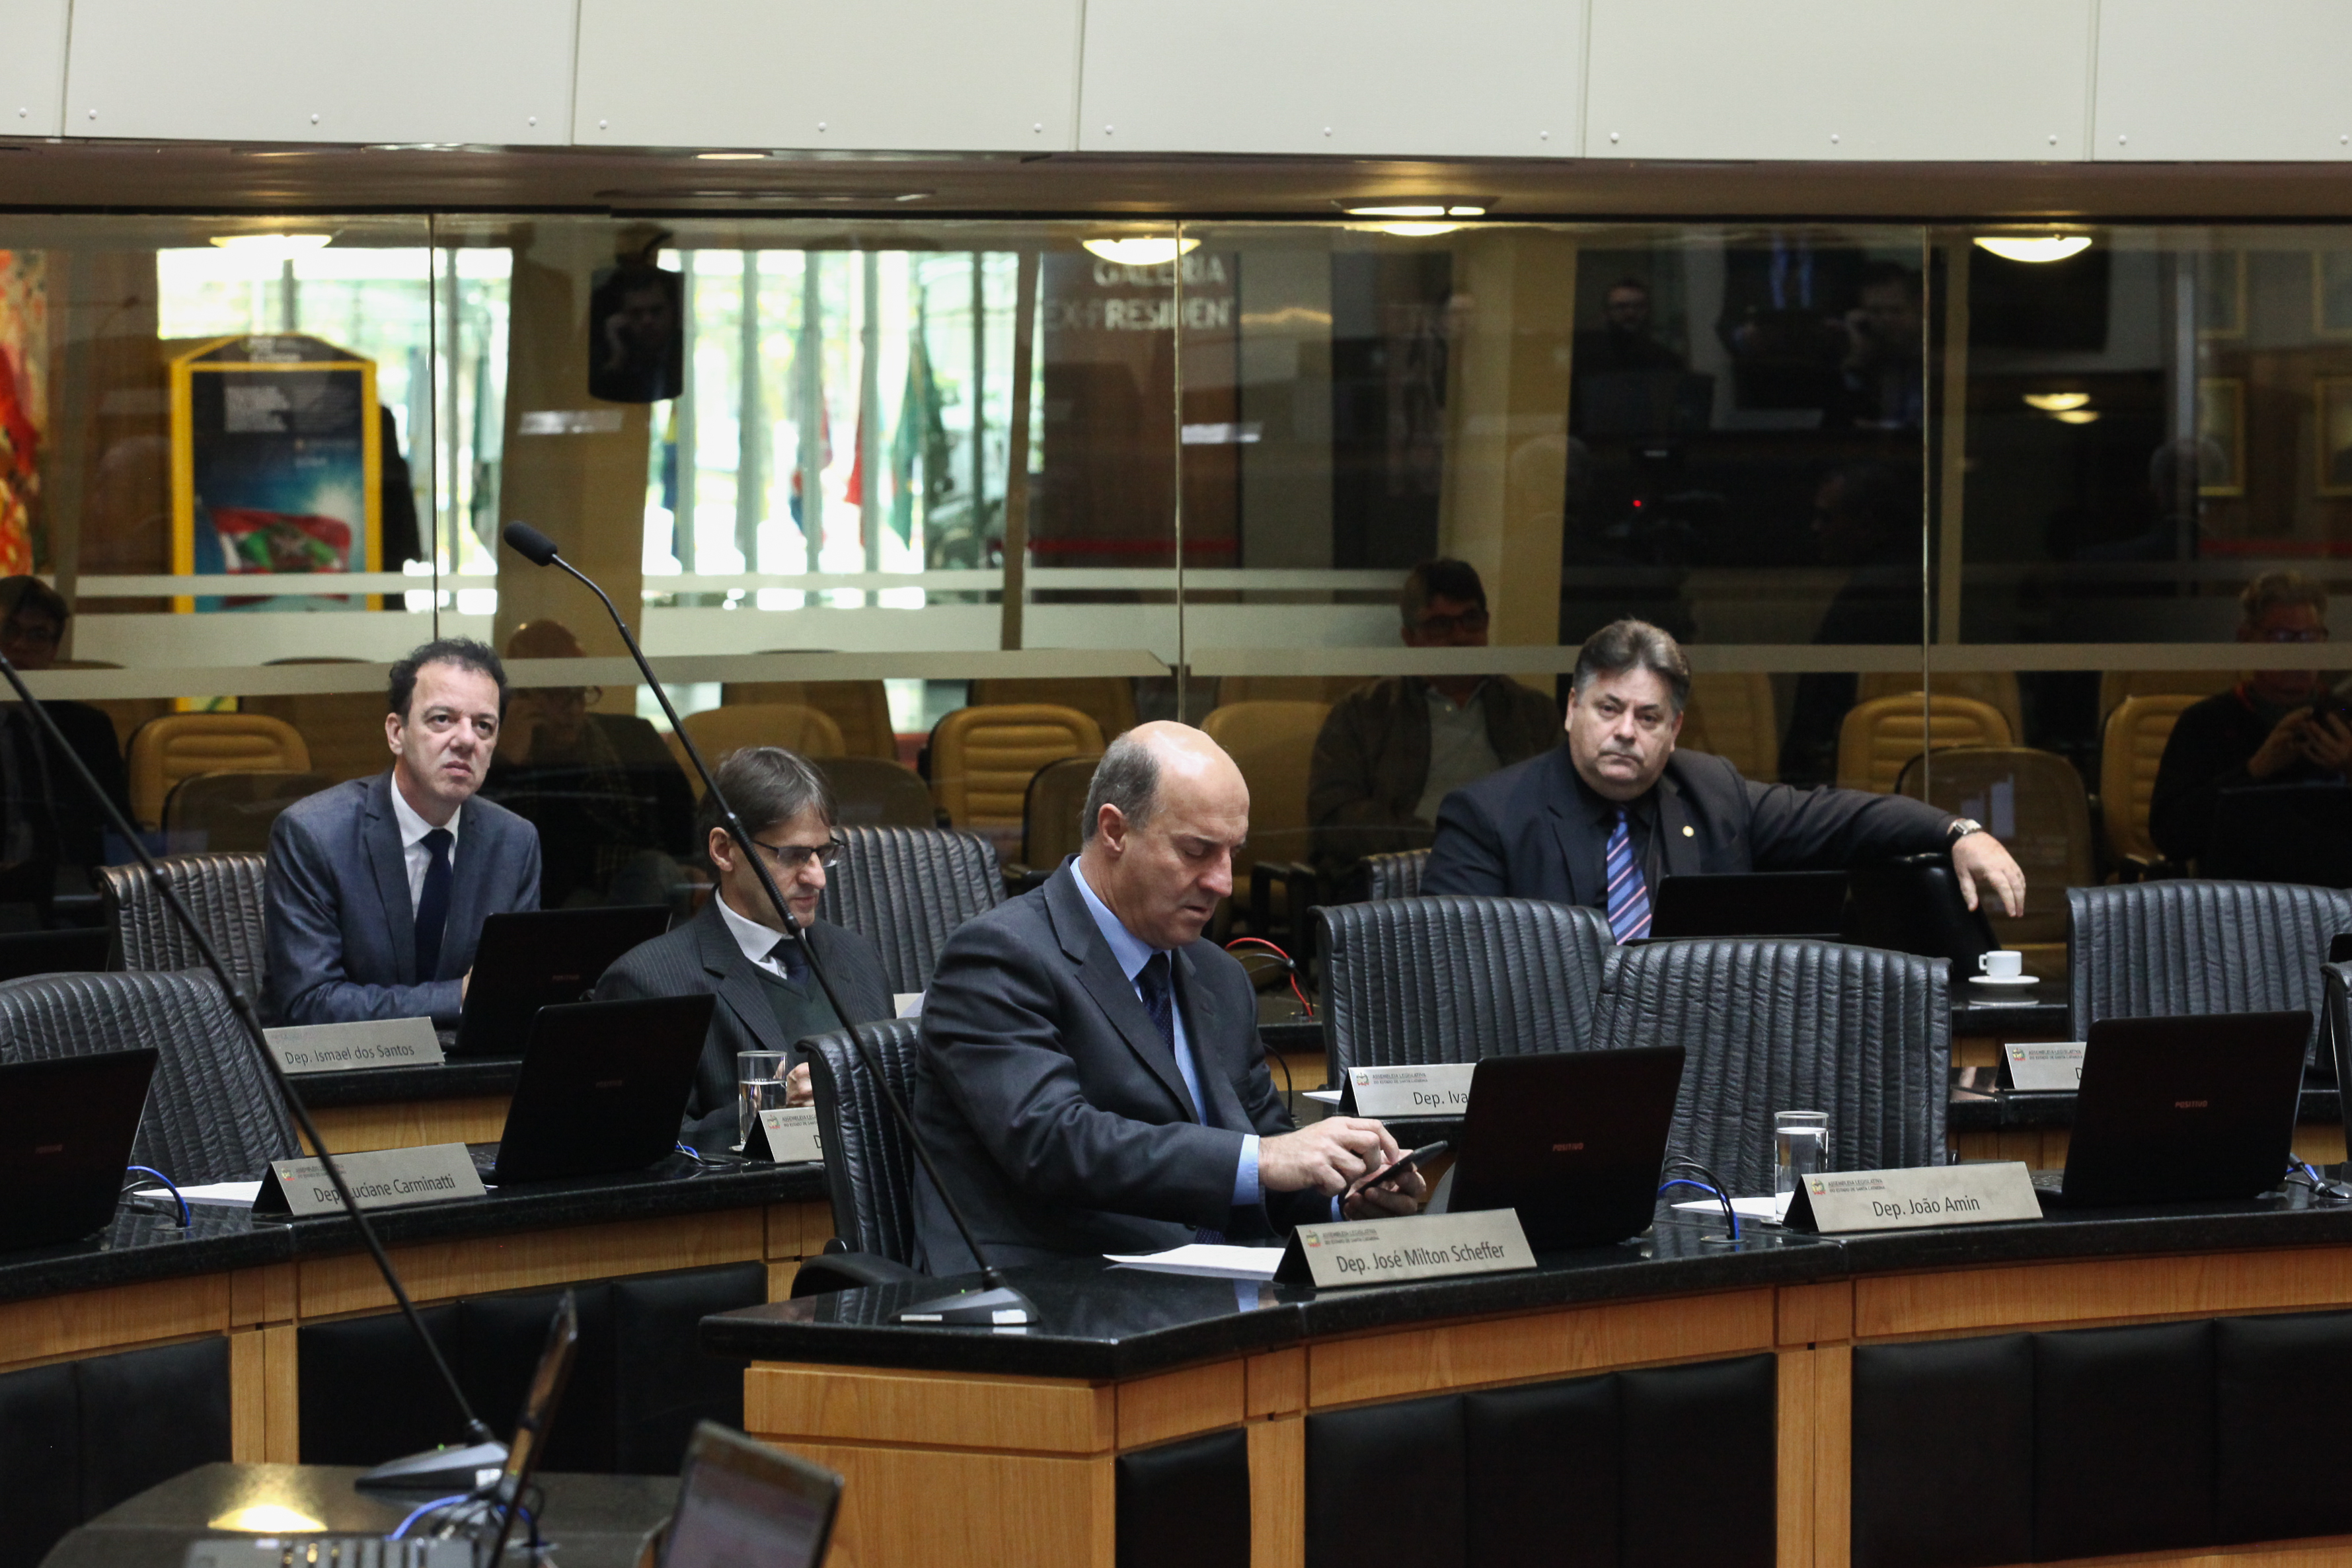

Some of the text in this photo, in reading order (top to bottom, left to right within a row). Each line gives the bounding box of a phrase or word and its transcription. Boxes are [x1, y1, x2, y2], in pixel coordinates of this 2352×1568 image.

[285, 1045, 415, 1066] Dep. Ismael dos Santos
[1413, 1092, 1445, 1107] Dep.
[2175, 1100, 2209, 1109] POSITIVO
[1552, 1142, 1585, 1152] POSITIVO
[393, 1174, 456, 1194] Carminatti
[1872, 1195, 1981, 1220] Dep. João Amin
[1336, 1241, 1506, 1275] Dep. José Milton Scheffer
